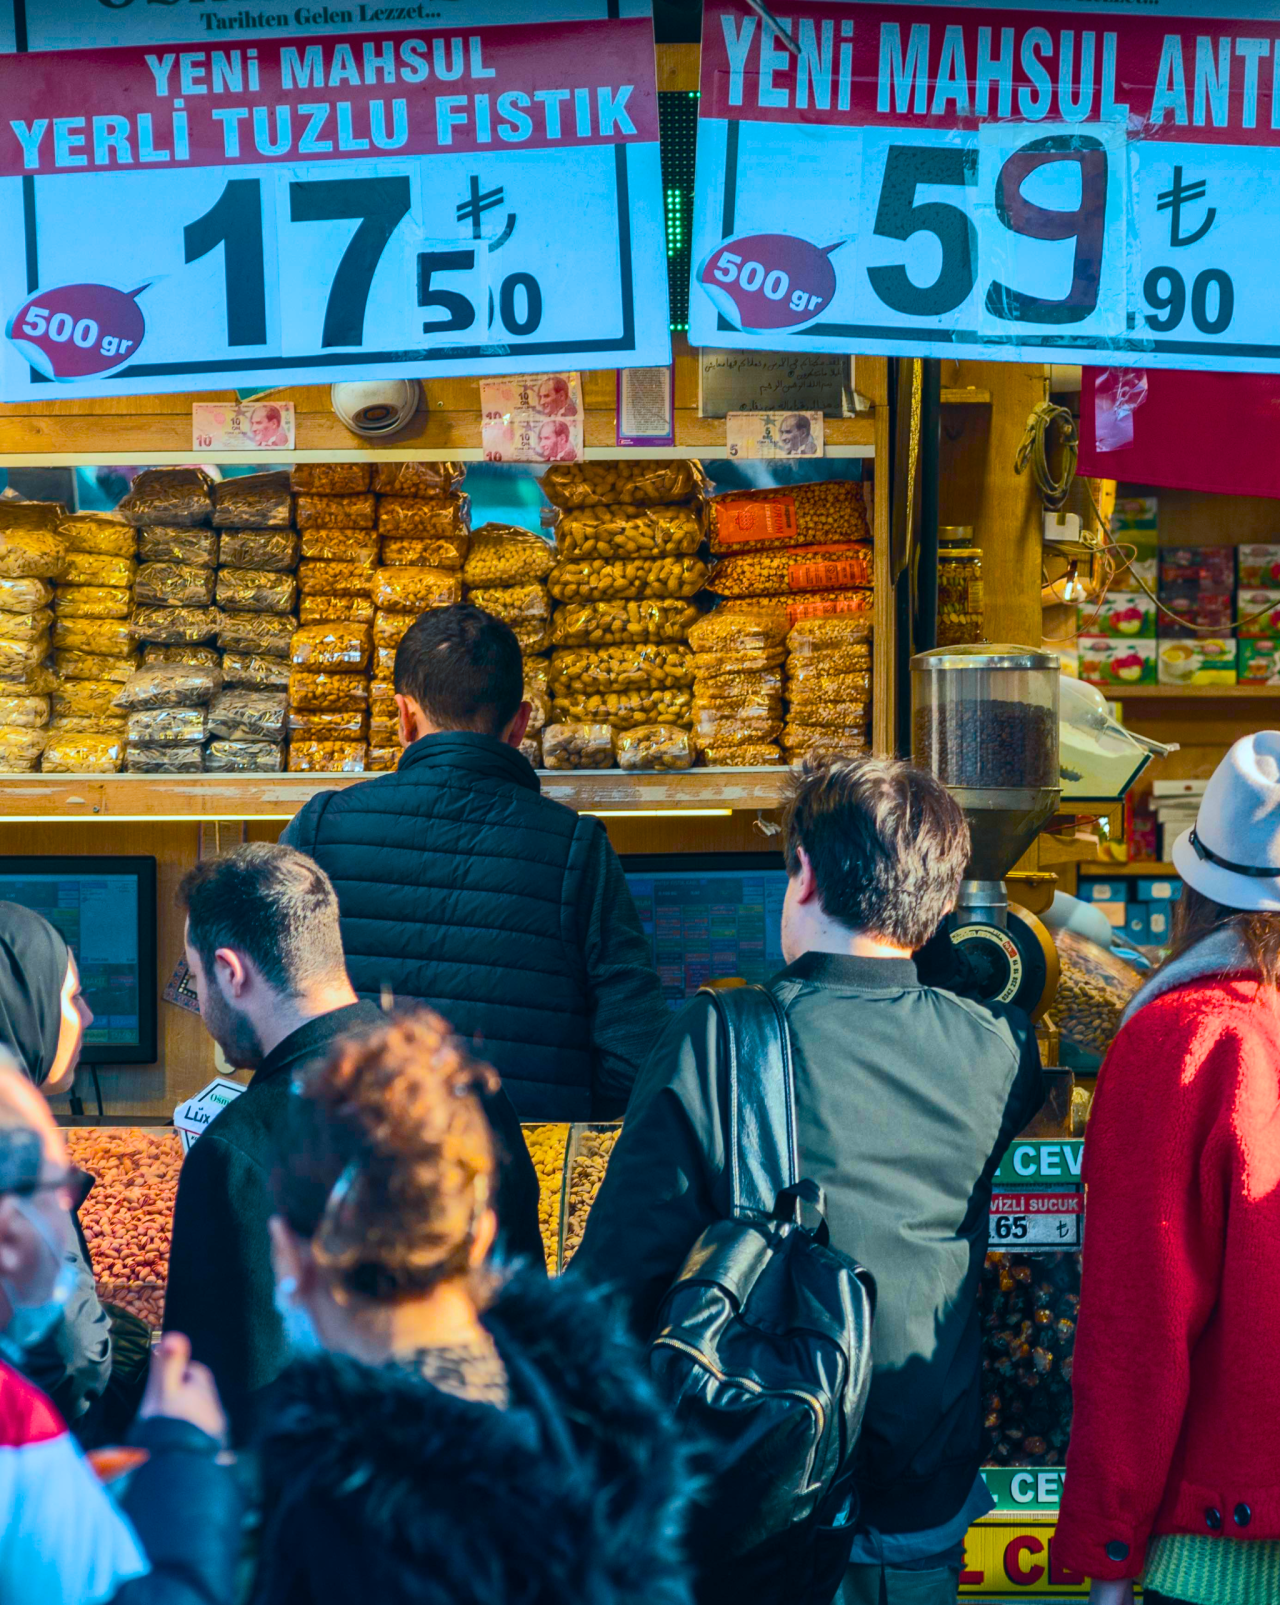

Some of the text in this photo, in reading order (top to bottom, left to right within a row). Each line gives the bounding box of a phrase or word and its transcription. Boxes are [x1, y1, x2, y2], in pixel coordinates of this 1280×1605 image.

[200, 11, 290, 31] Tarihten
[294, 7, 353, 26] Gelen
[359, 3, 442, 22] Lezzet...
[280, 36, 496, 89] MAHSUL
[876, 23, 1130, 122] MAHSUL
[10, 85, 638, 171] YERLİ TUZLU FISTIK
[866, 133, 1107, 325] 59
[183, 176, 412, 348] 17
[712, 253, 823, 315] 500 gr
[21, 305, 134, 358] 500 gr
[196, 433, 213, 447] 10
[729, 443, 739, 456] 5
[485, 451, 503, 463] 10
[209, 1093, 230, 1106] Osm
[1013, 1145, 1084, 1176] CEV
[990, 1196, 1079, 1212] VİZLİ SUCUK
[995, 1215, 1028, 1240] 65
